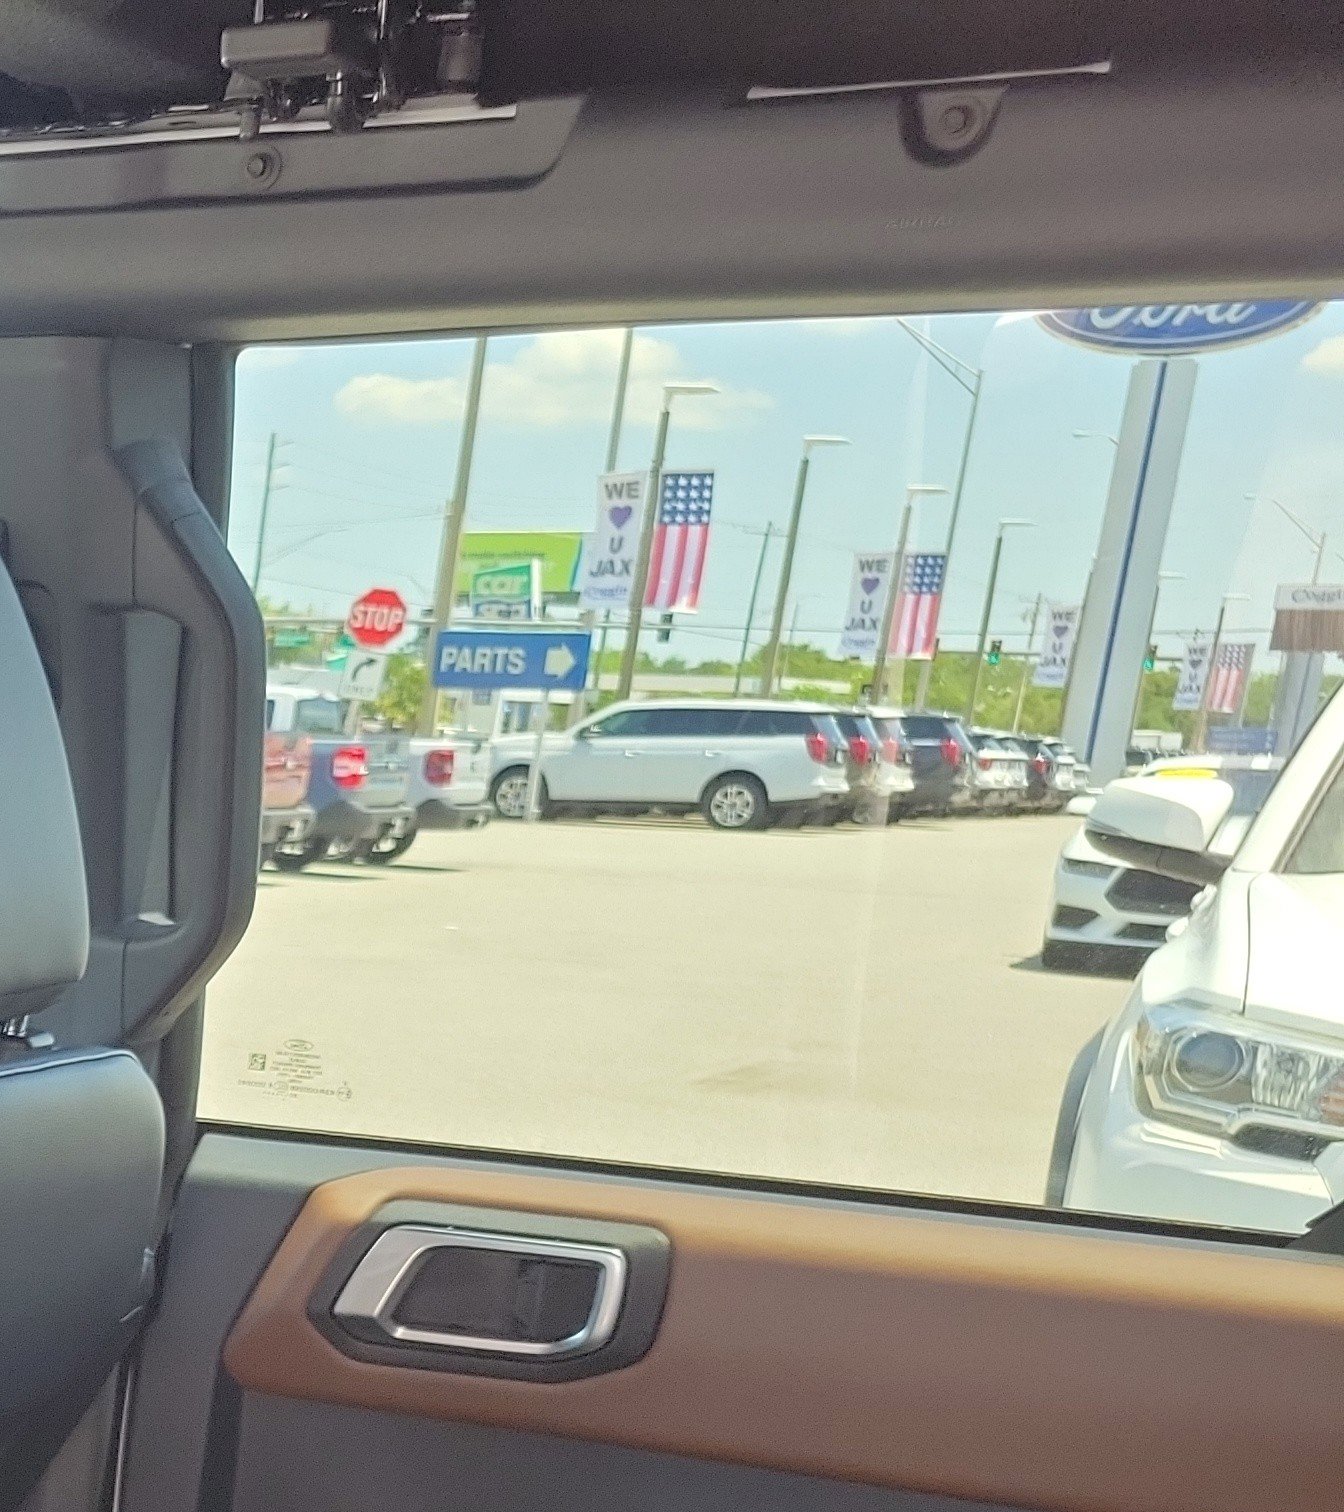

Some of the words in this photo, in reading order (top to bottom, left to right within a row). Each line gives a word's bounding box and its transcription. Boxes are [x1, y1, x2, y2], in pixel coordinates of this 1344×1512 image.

[604, 481, 640, 499] WE
[609, 536, 623, 554] U
[590, 559, 632, 577] JAX
[859, 559, 888, 573] WE
[860, 600, 872, 614] U
[350, 603, 403, 632] STOP
[845, 617, 878, 631] JAX
[439, 646, 526, 674] PARTS
